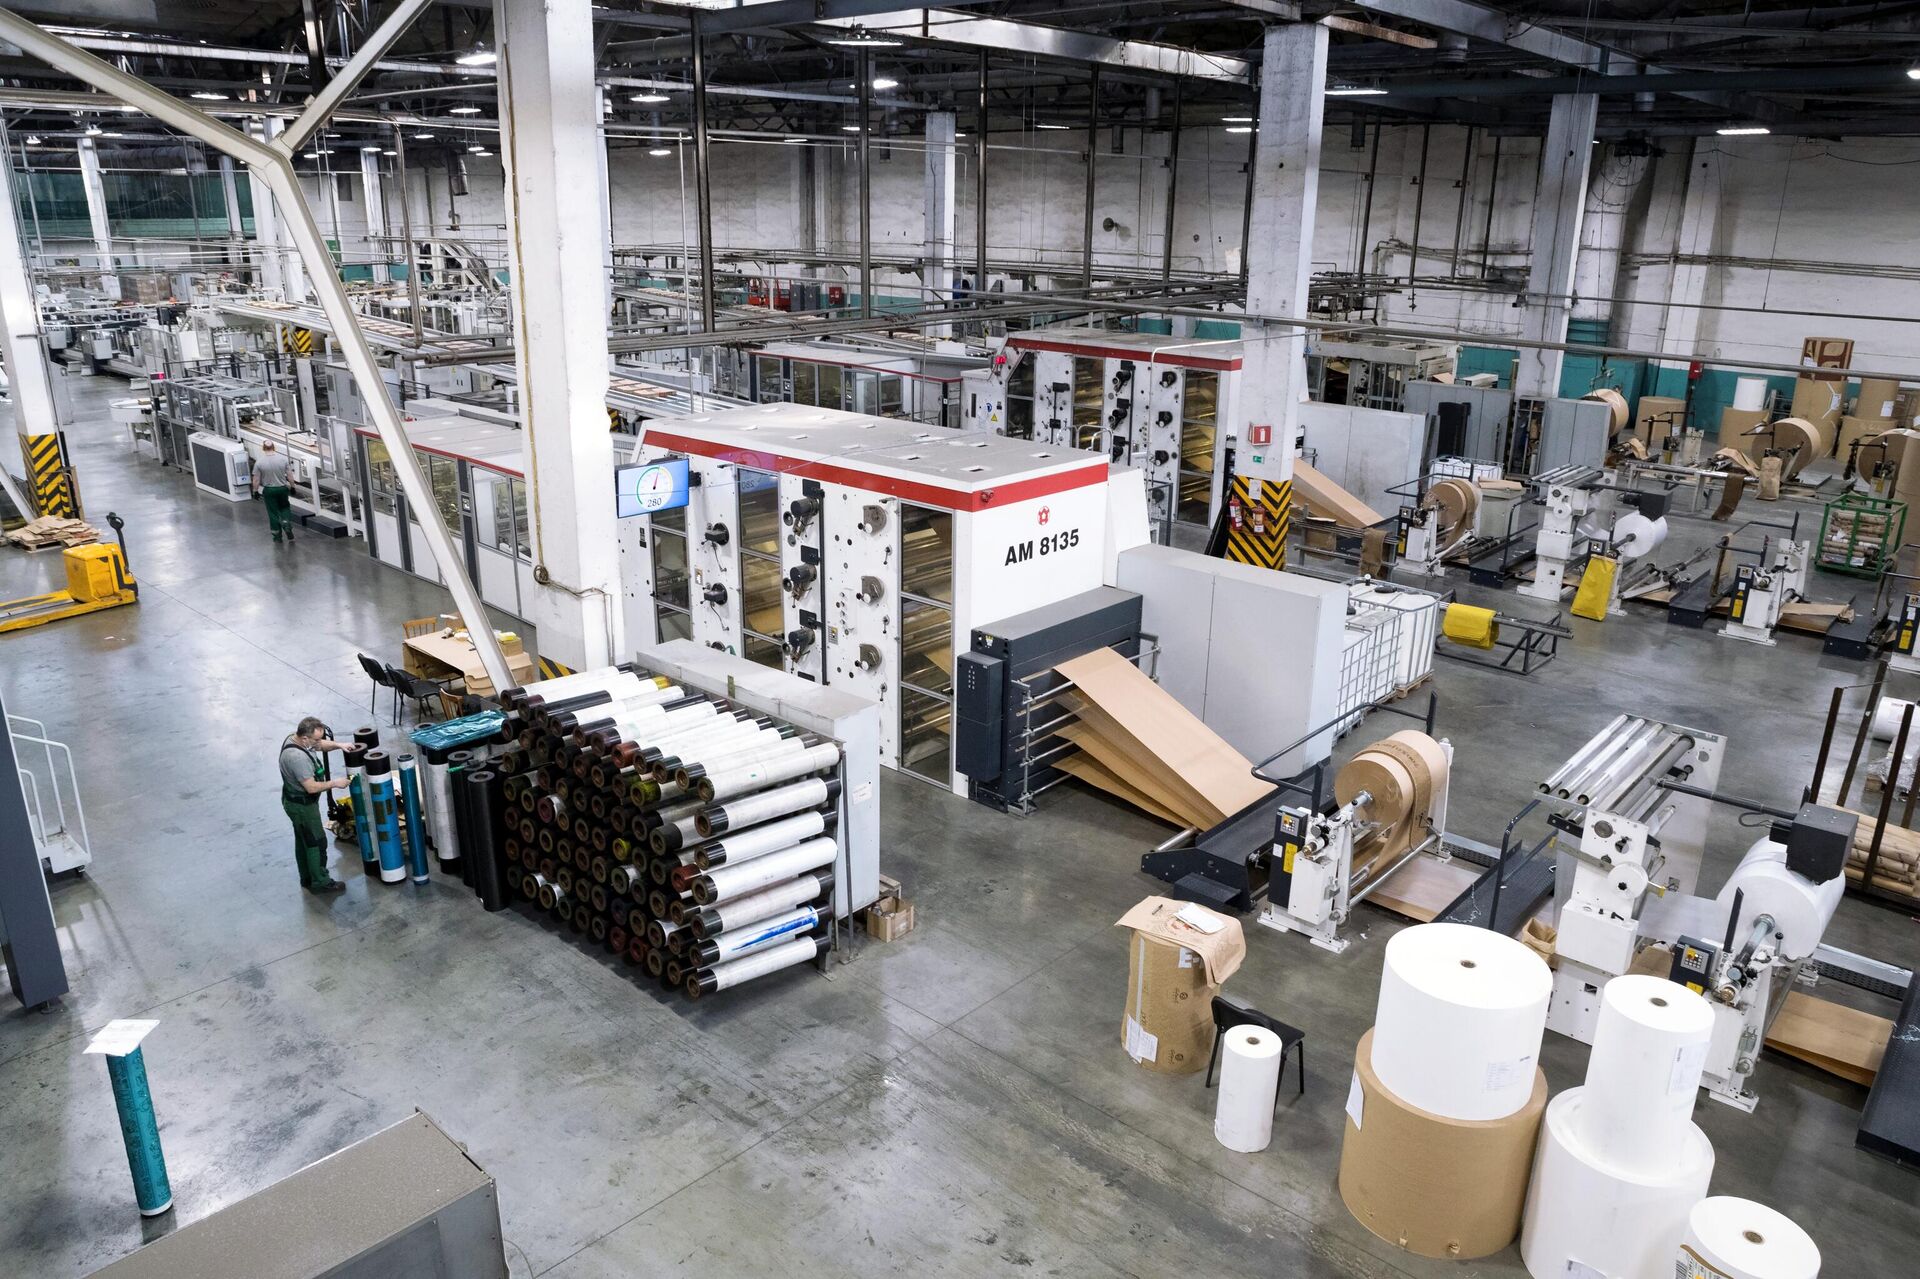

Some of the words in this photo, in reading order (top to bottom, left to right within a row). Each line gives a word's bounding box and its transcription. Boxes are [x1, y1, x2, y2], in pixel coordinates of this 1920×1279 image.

[647, 497, 662, 508] 280
[1004, 540, 1034, 567] AM
[1039, 528, 1080, 556] 8135
